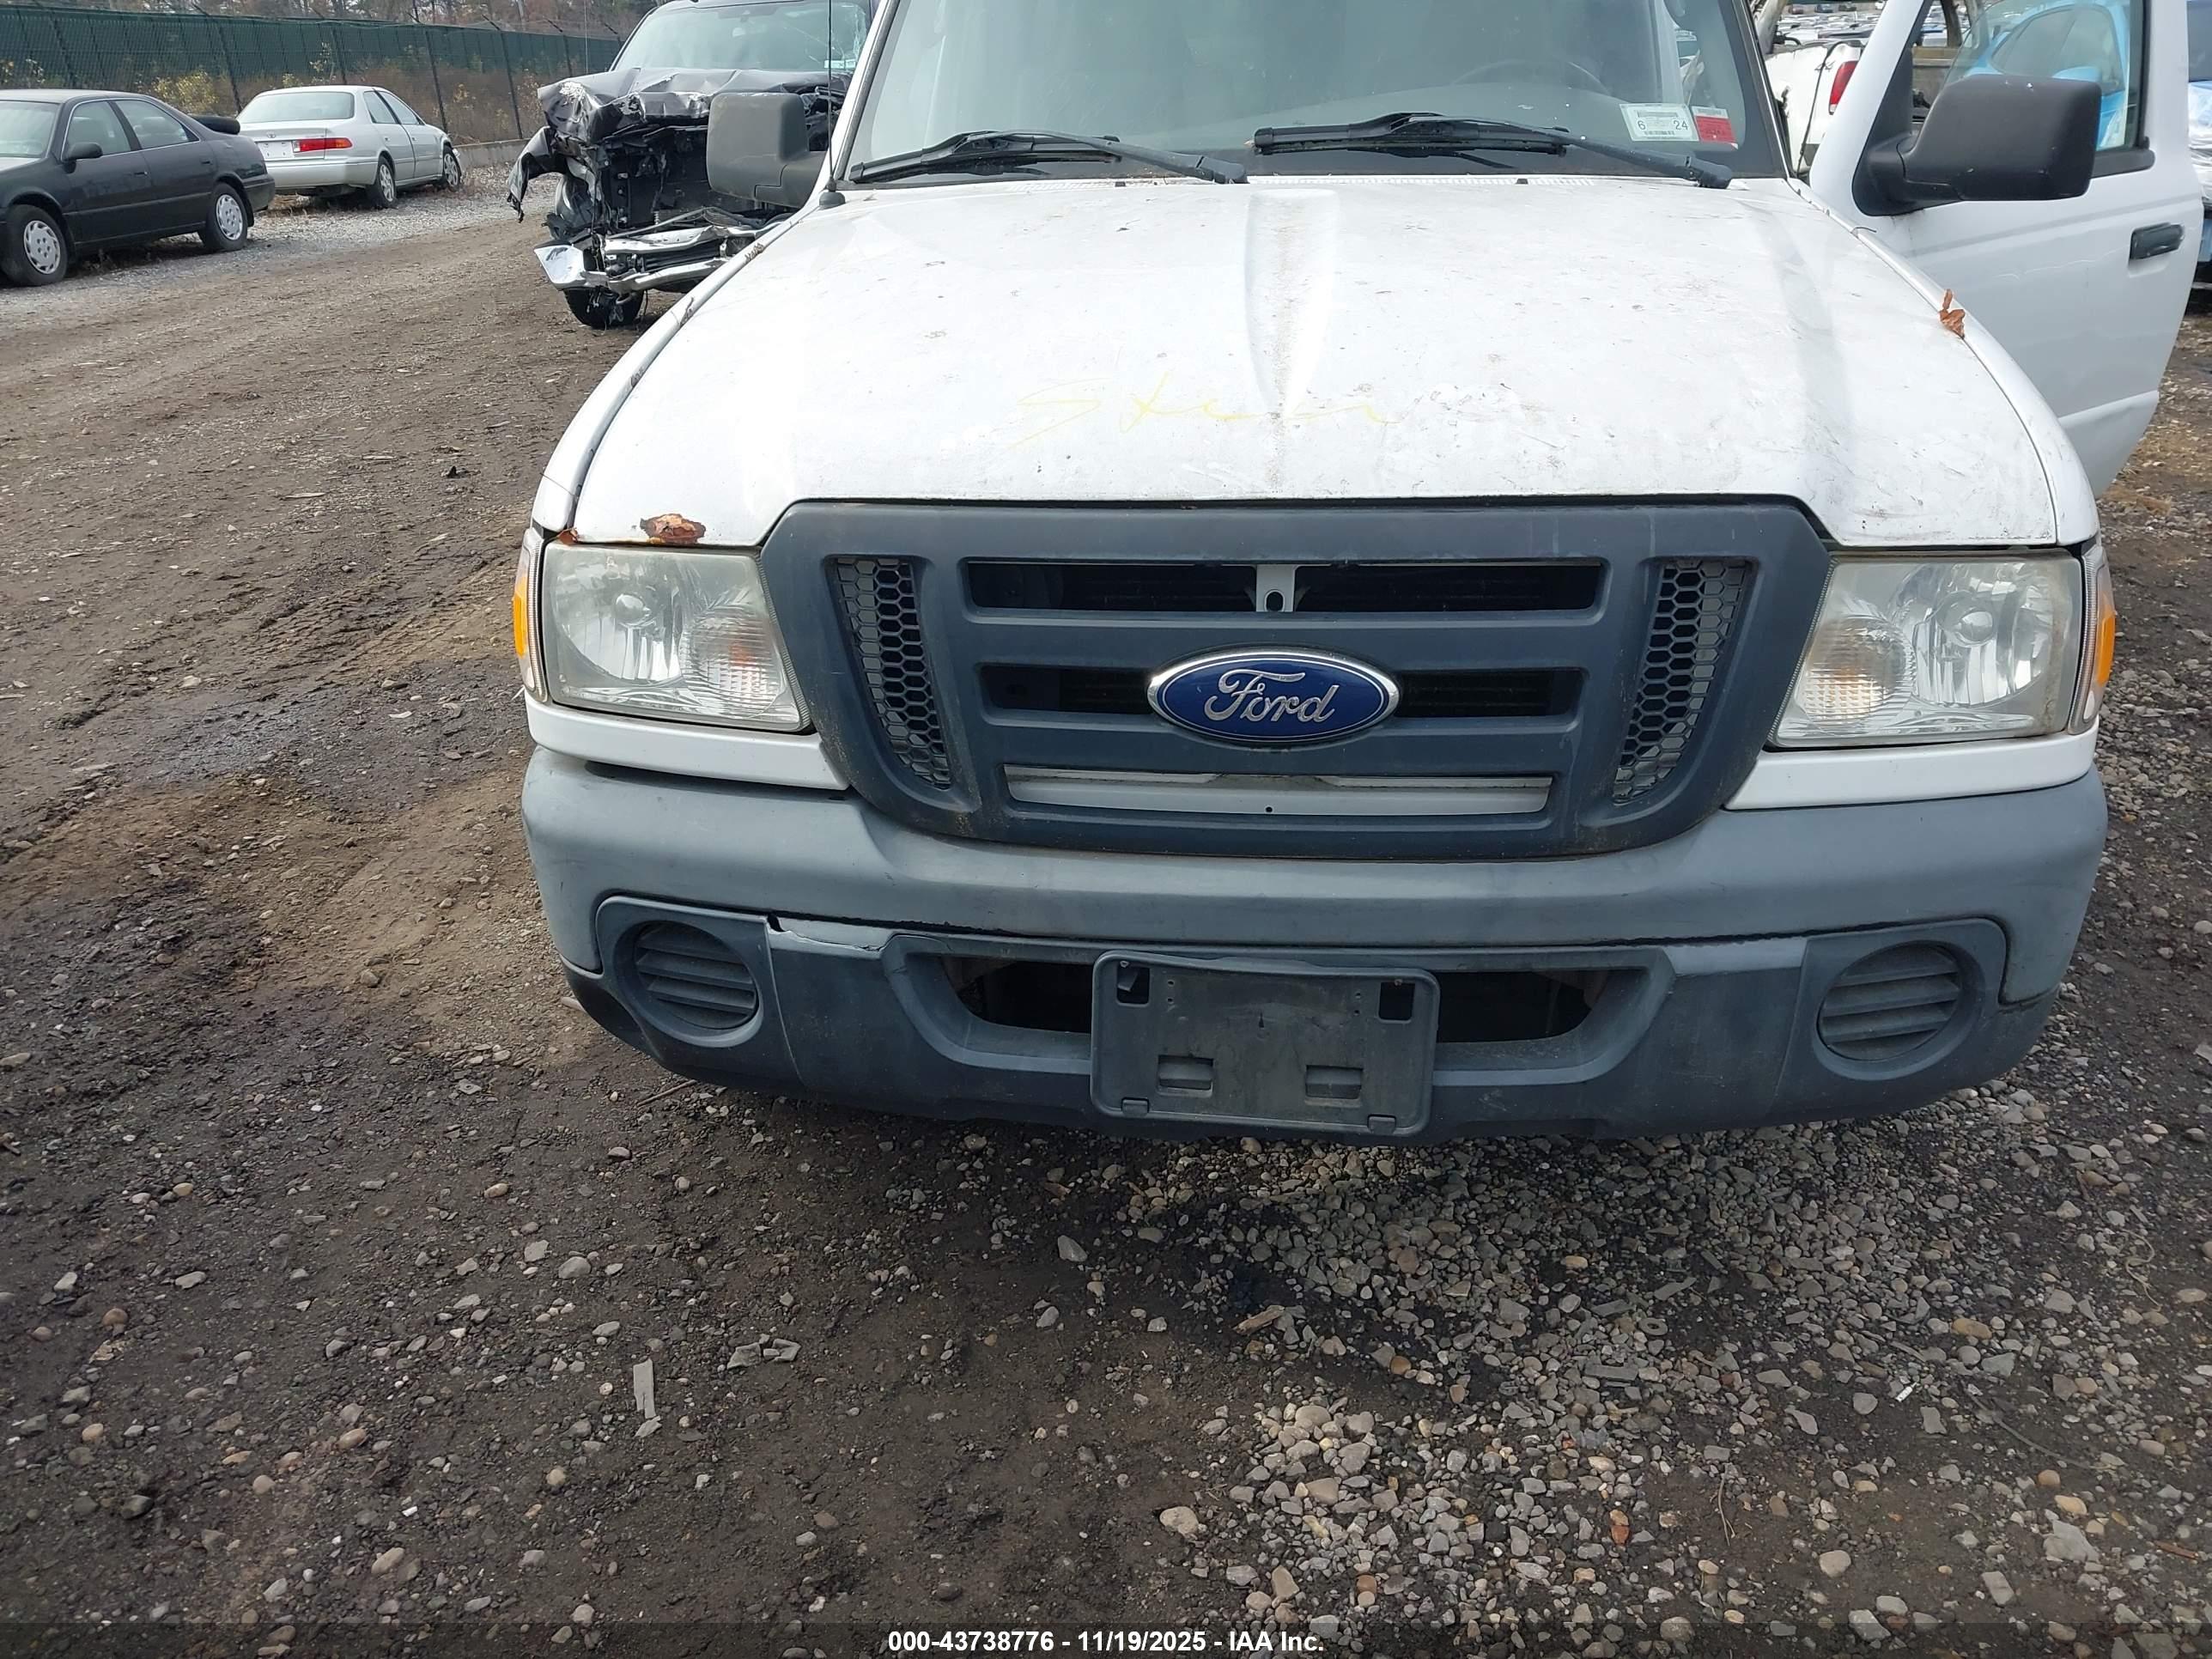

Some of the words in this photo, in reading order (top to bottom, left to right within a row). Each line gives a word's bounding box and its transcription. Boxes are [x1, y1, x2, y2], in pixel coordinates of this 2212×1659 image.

[1637, 120, 1646, 131] 6
[1673, 120, 1688, 131] 24
[1204, 669, 1340, 722] Ford
